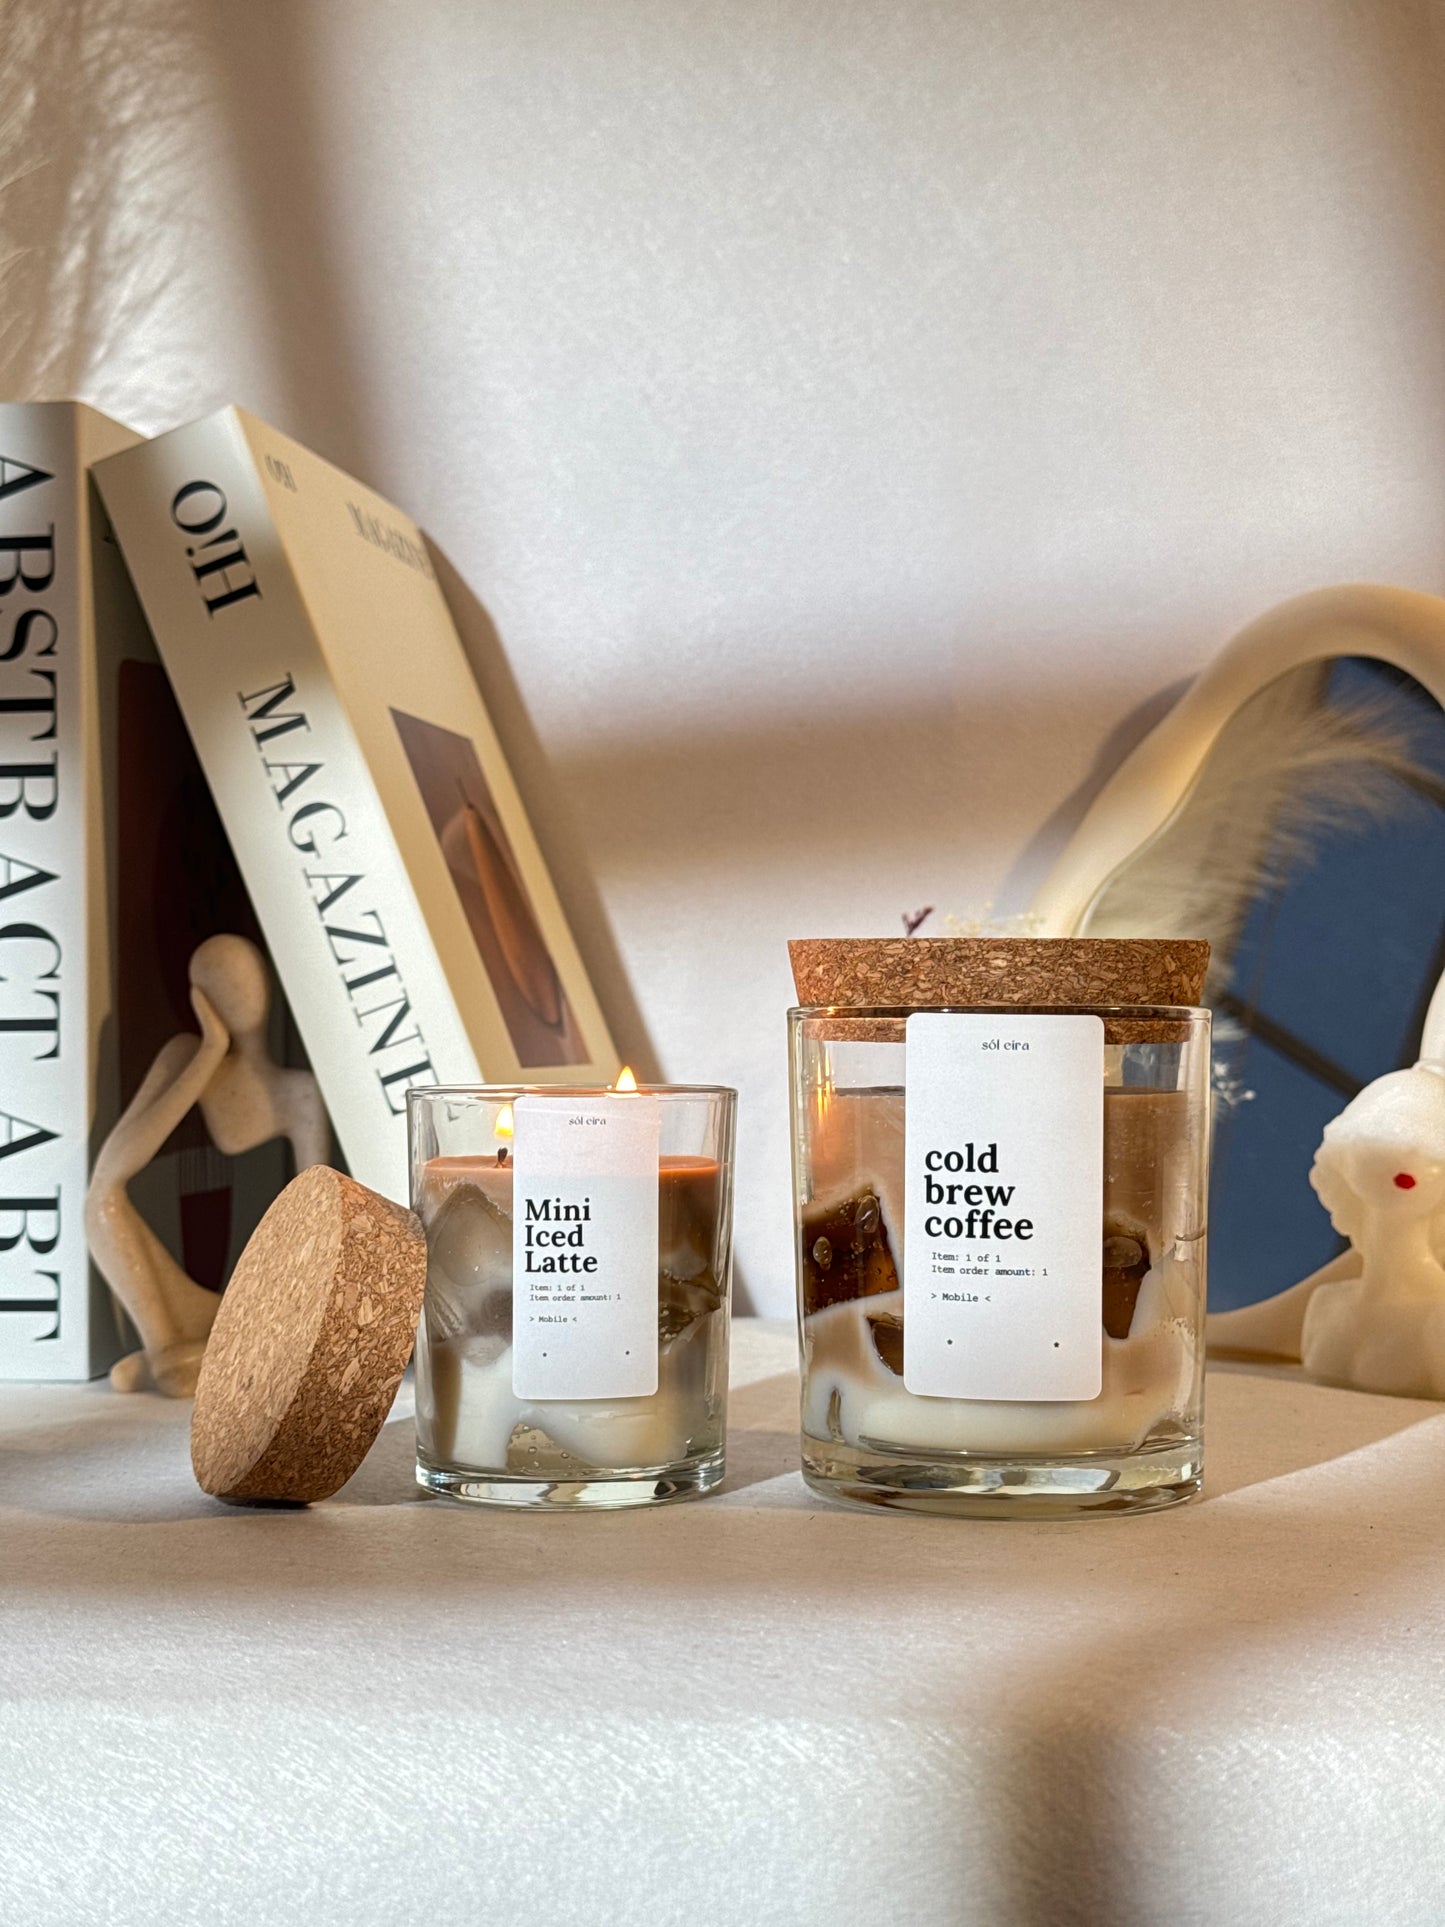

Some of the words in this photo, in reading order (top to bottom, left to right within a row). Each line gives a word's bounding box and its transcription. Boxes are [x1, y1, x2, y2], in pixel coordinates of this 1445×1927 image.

[0, 455, 63, 1061] ABSTRACT
[237, 671, 441, 1117] MAGAZINE
[924, 1142, 999, 1174] cold
[924, 1174, 1016, 1207] brew
[525, 1197, 591, 1221] Mini
[0, 1111, 62, 1342] ART
[525, 1223, 585, 1248] Iced
[924, 1208, 1034, 1241] coffee
[525, 1250, 599, 1274] Latte
[931, 1252, 960, 1262] Item:
[977, 1254, 991, 1263] of
[931, 1264, 956, 1274] Item
[959, 1266, 990, 1276] order
[994, 1268, 1036, 1277] amount:
[529, 1284, 553, 1292] Item:
[566, 1284, 577, 1292] of
[529, 1294, 549, 1302] Item
[552, 1294, 576, 1302] order
[580, 1294, 613, 1302] amount:
[942, 1293, 979, 1303] Mobile
[538, 1315, 568, 1323] Mobile
